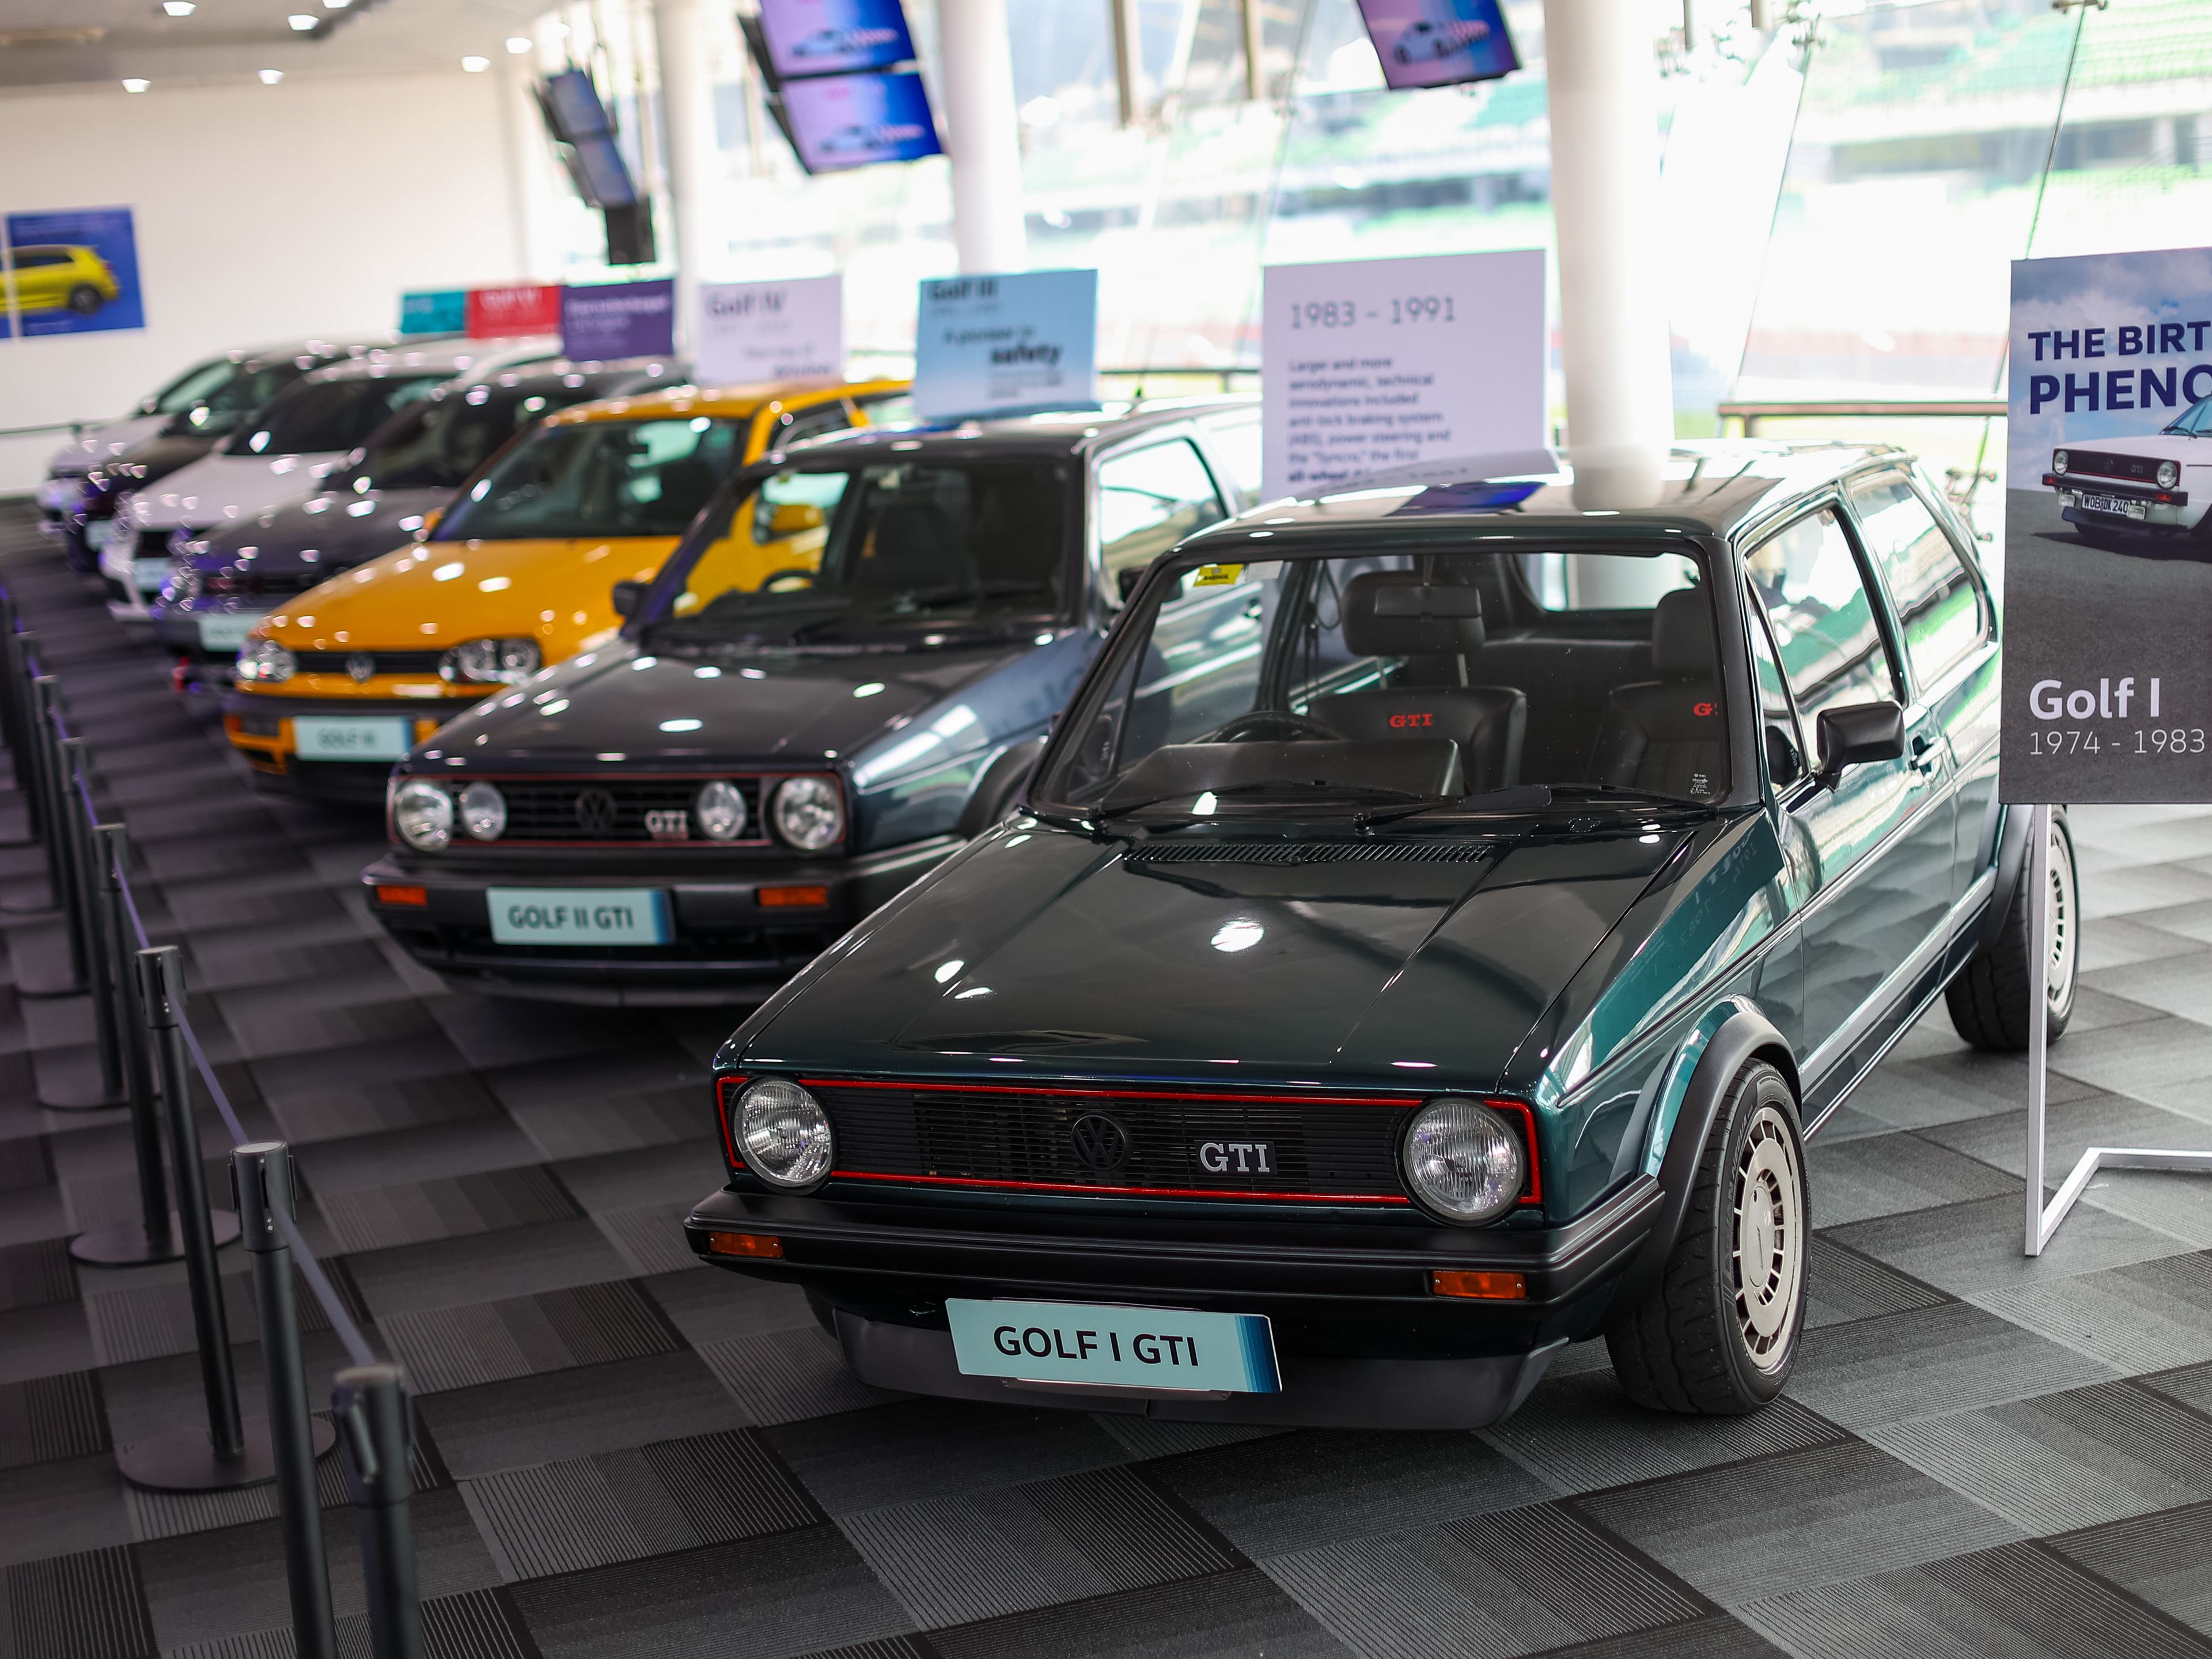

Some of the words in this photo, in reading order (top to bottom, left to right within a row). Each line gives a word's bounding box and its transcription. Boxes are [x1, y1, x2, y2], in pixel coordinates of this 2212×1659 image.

[1290, 300, 1356, 329] 1983
[1391, 296, 1456, 325] 1991
[2028, 328, 2105, 361] THE
[2119, 321, 2211, 356] BIRT
[990, 342, 1063, 367] safety
[1290, 361, 1327, 374] Larger
[1333, 359, 1355, 369] and
[1360, 359, 1392, 369] more
[1377, 373, 1434, 385] technical
[1365, 393, 1419, 405] included
[1347, 413, 1394, 427] braking
[1398, 413, 1442, 425] system
[1328, 433, 1366, 447] power
[1372, 431, 1422, 444] steering
[1427, 429, 1451, 441] and
[1290, 452, 1308, 463] the
[1371, 450, 1389, 461] the
[1394, 448, 1419, 460] first
[2084, 495, 2101, 509] WOB
[2113, 500, 2128, 513] 240
[2029, 677, 2134, 720] Golf
[2150, 677, 2160, 718] I
[1694, 702, 1718, 717] G
[1389, 713, 1433, 728] GTI
[2030, 731, 2101, 755] 1974
[2134, 729, 2206, 753] 1983
[645, 810, 688, 833] GTI
[507, 905, 567, 930] GOLF
[574, 907, 588, 929] II
[594, 906, 634, 930] GTI
[1200, 1142, 1270, 1173] GTI
[993, 1325, 1098, 1360] GOLF
[1109, 1332, 1122, 1362] I
[1132, 1333, 1199, 1366] GTI
